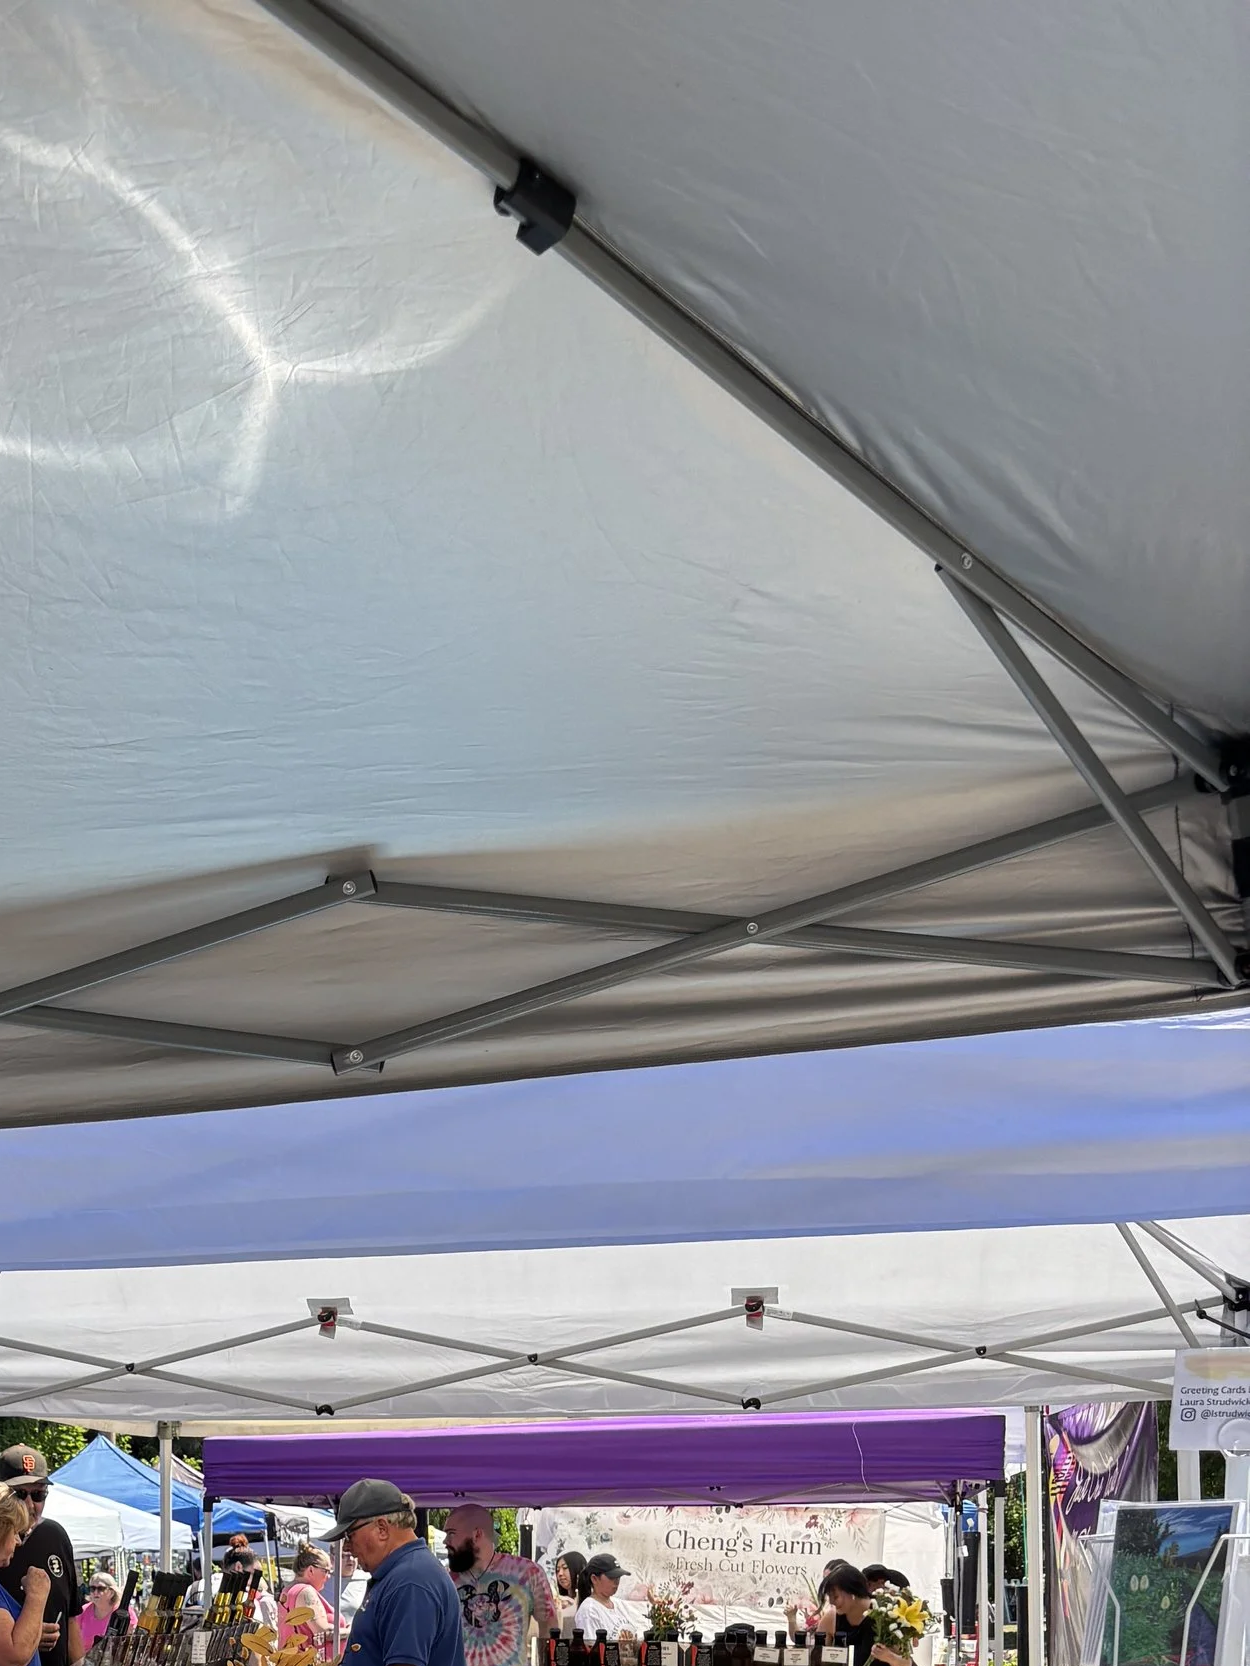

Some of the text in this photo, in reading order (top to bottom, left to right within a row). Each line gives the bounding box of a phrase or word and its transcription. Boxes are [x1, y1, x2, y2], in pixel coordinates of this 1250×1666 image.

[1180, 1386, 1247, 1396] Greeting Cards
[1179, 1398, 1205, 1406] Laura
[665, 1529, 822, 1558] Cheng's Farm
[675, 1557, 807, 1575] Fresh Cut Flowers
